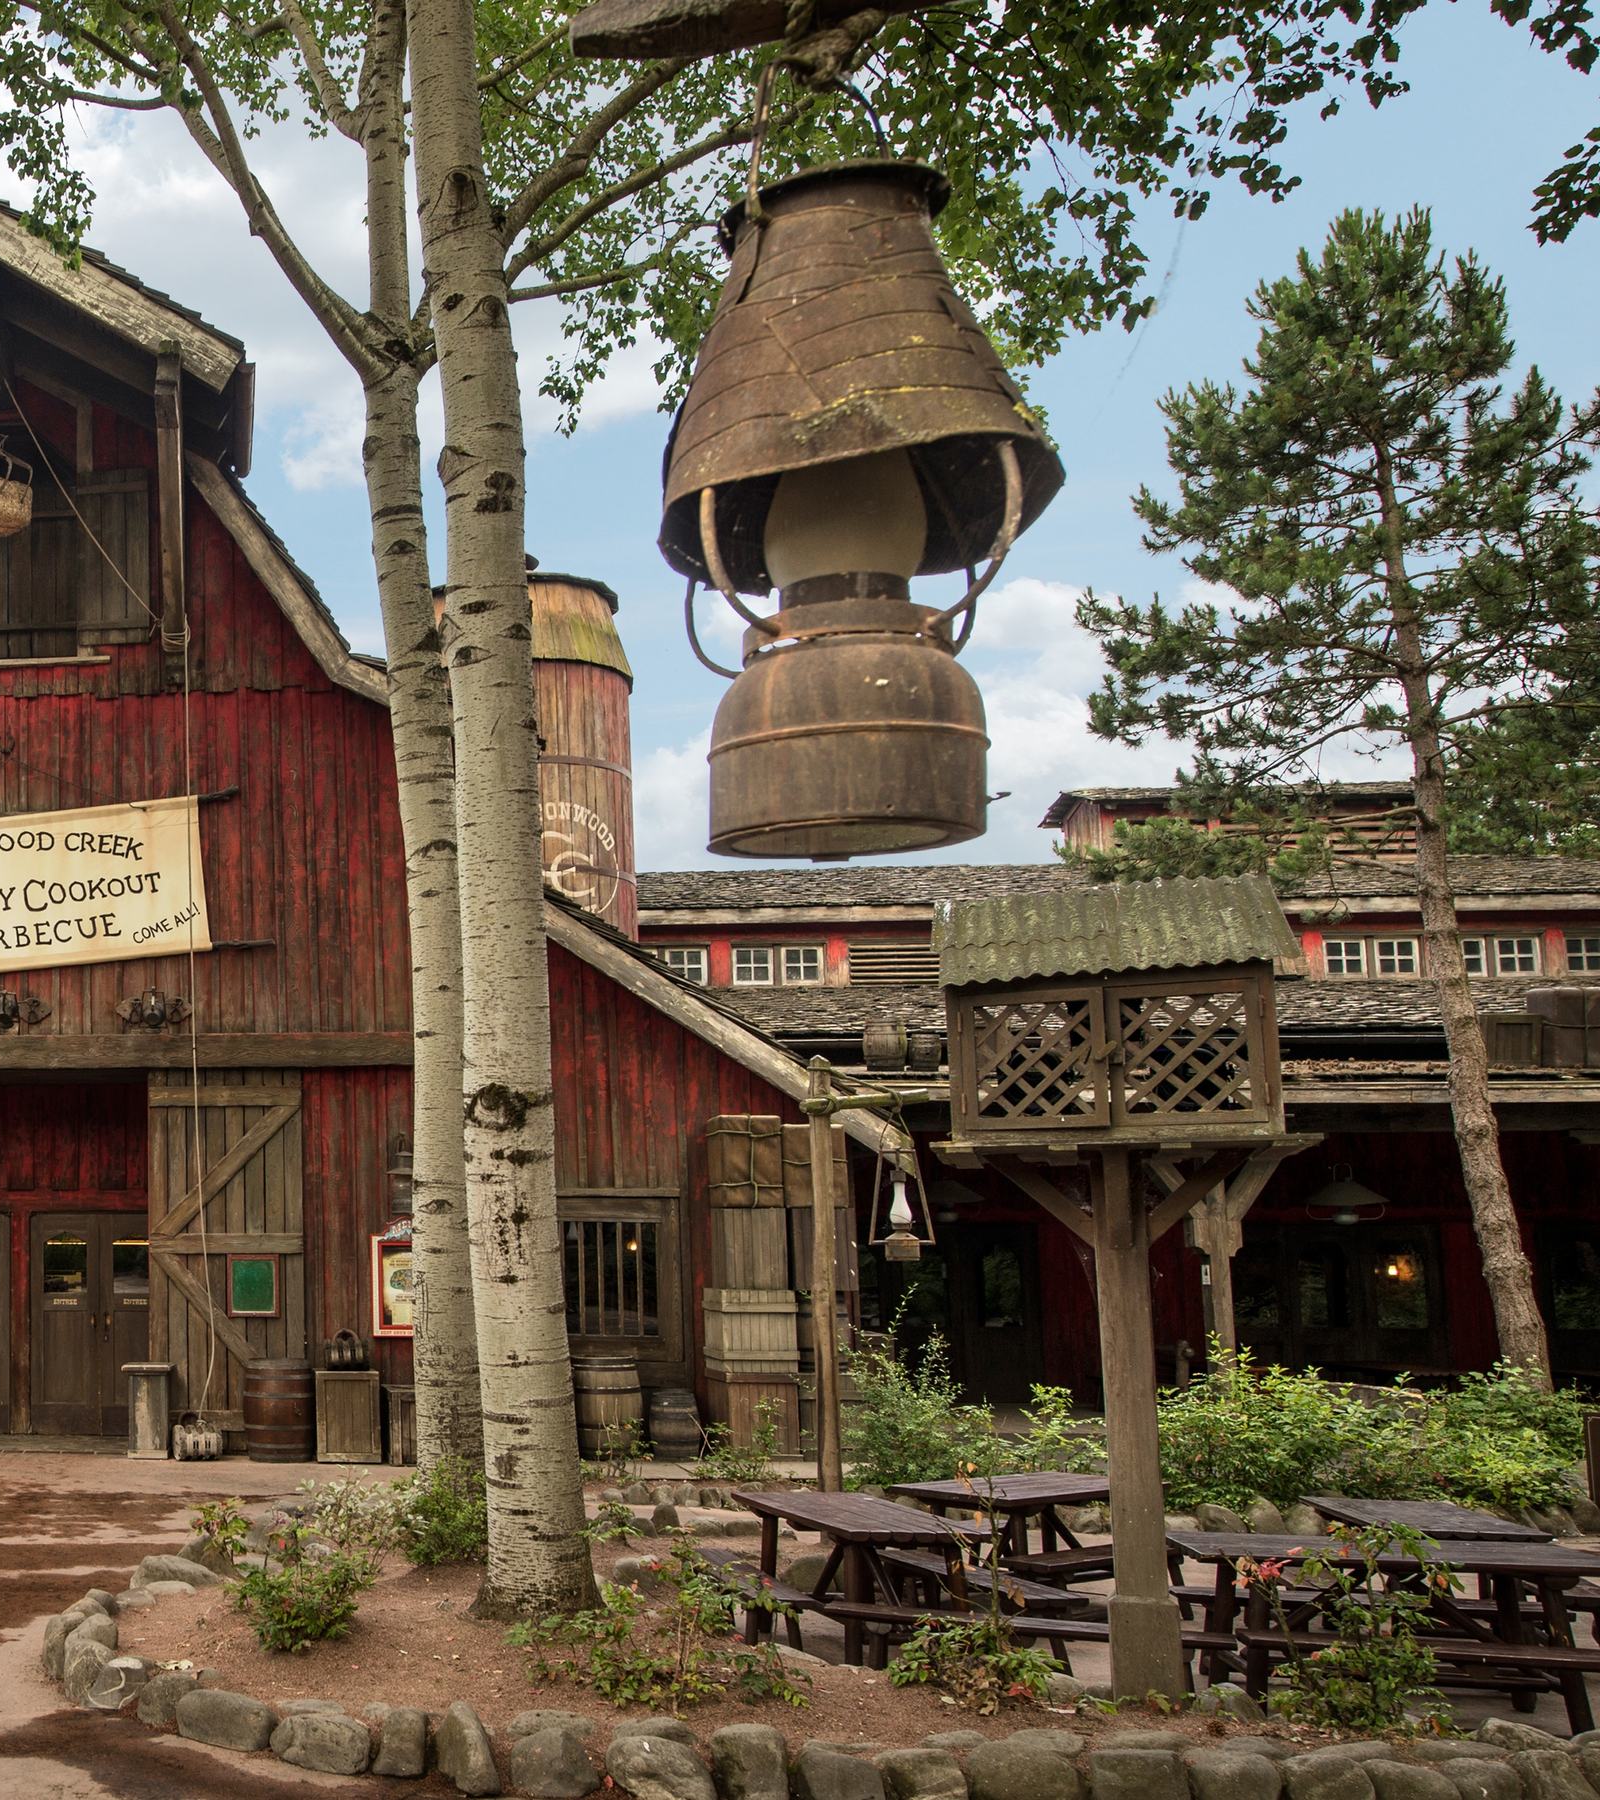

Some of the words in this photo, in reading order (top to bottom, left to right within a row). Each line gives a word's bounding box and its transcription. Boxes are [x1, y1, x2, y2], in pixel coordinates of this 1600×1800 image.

[64, 832, 144, 861] CREEK
[23, 872, 161, 913] COOKOUT
[132, 918, 173, 944] COME
[173, 902, 201, 931] ALL!
